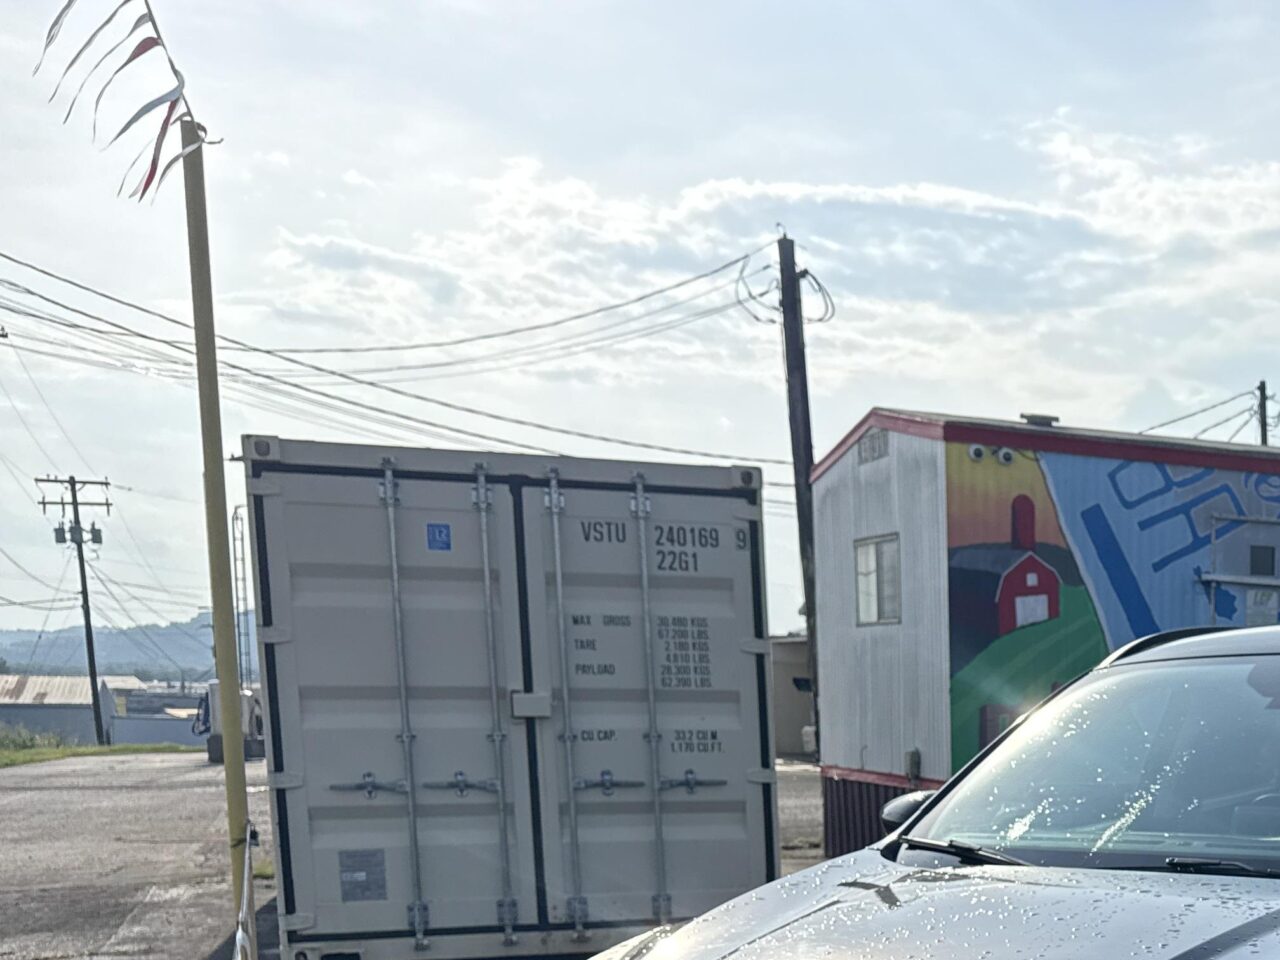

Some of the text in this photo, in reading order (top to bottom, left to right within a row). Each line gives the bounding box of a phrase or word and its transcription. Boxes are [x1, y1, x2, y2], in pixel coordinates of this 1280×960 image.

[581, 520, 748, 550] VSTU 240169 9
[656, 550, 699, 572] 22G1
[572, 615, 591, 626] MAX
[574, 639, 597, 651] TARE
[575, 663, 616, 676] PAYLOAD
